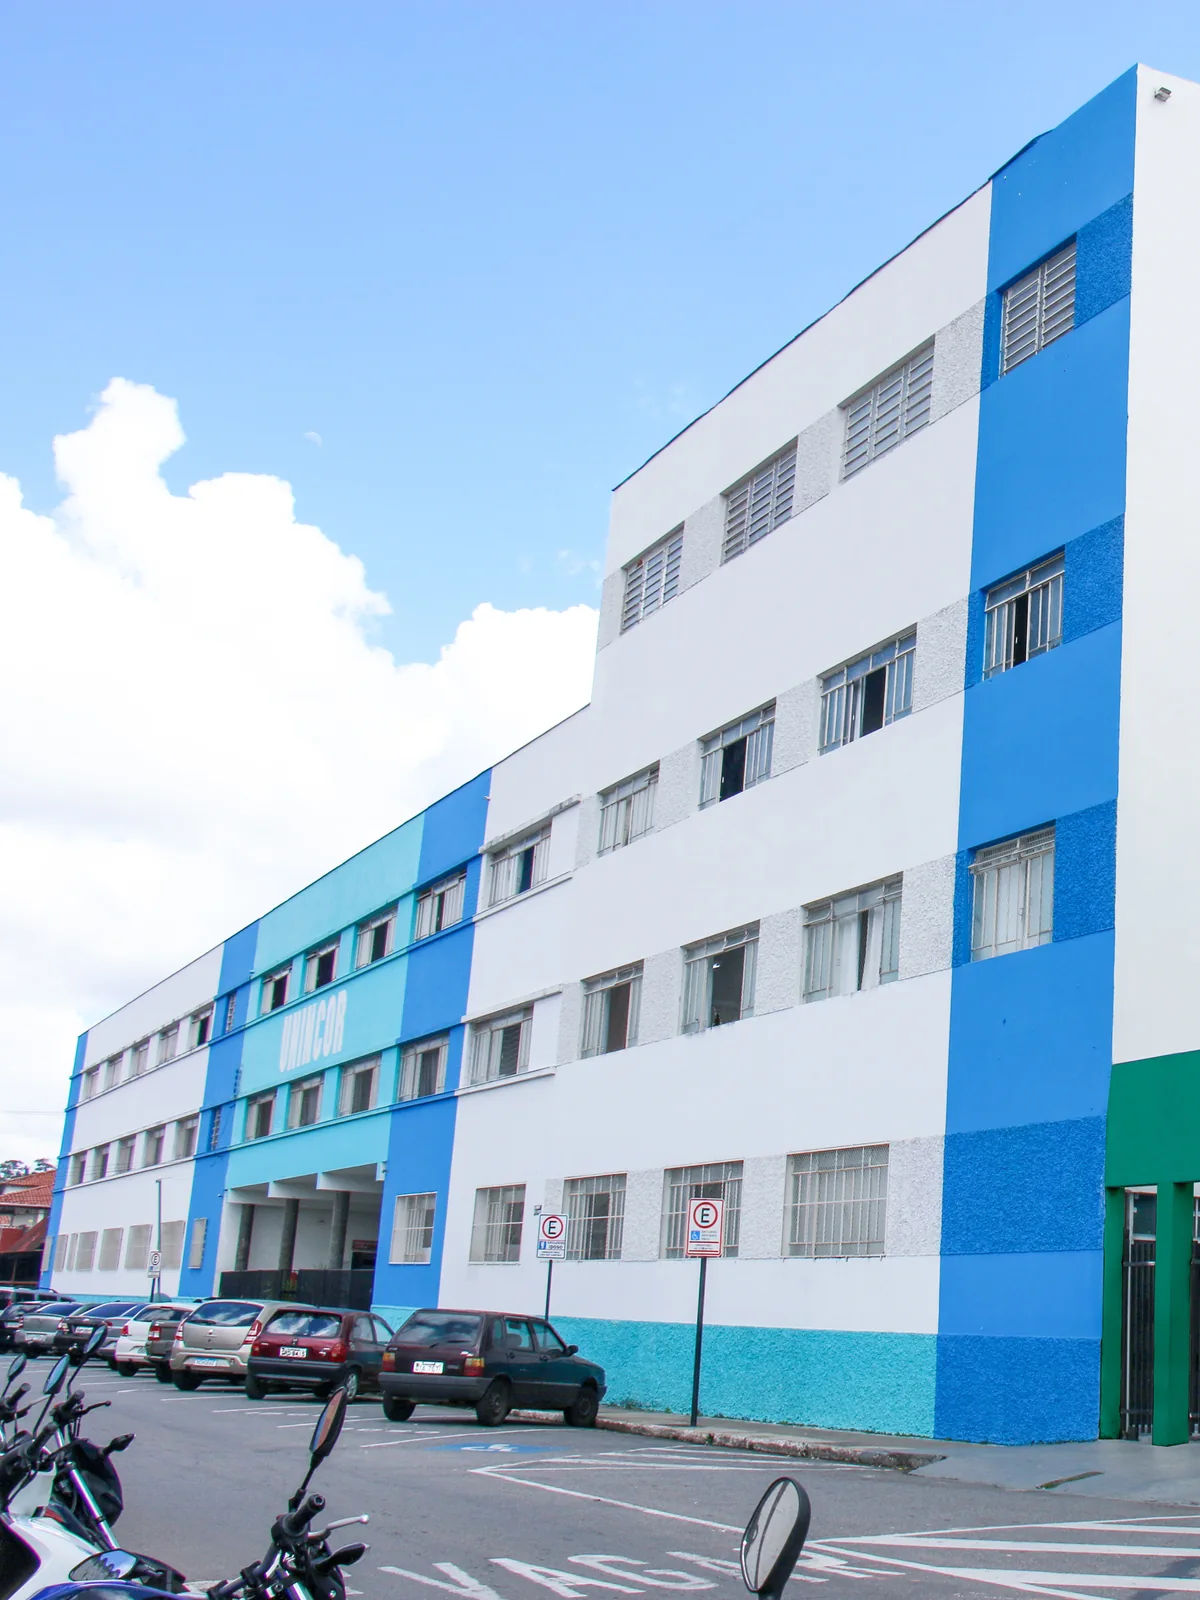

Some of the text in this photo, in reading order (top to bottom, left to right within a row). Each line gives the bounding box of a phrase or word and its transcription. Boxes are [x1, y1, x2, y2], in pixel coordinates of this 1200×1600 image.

[279, 989, 347, 1072] UNINCOR
[701, 1207, 711, 1223] E
[548, 1220, 557, 1235] E
